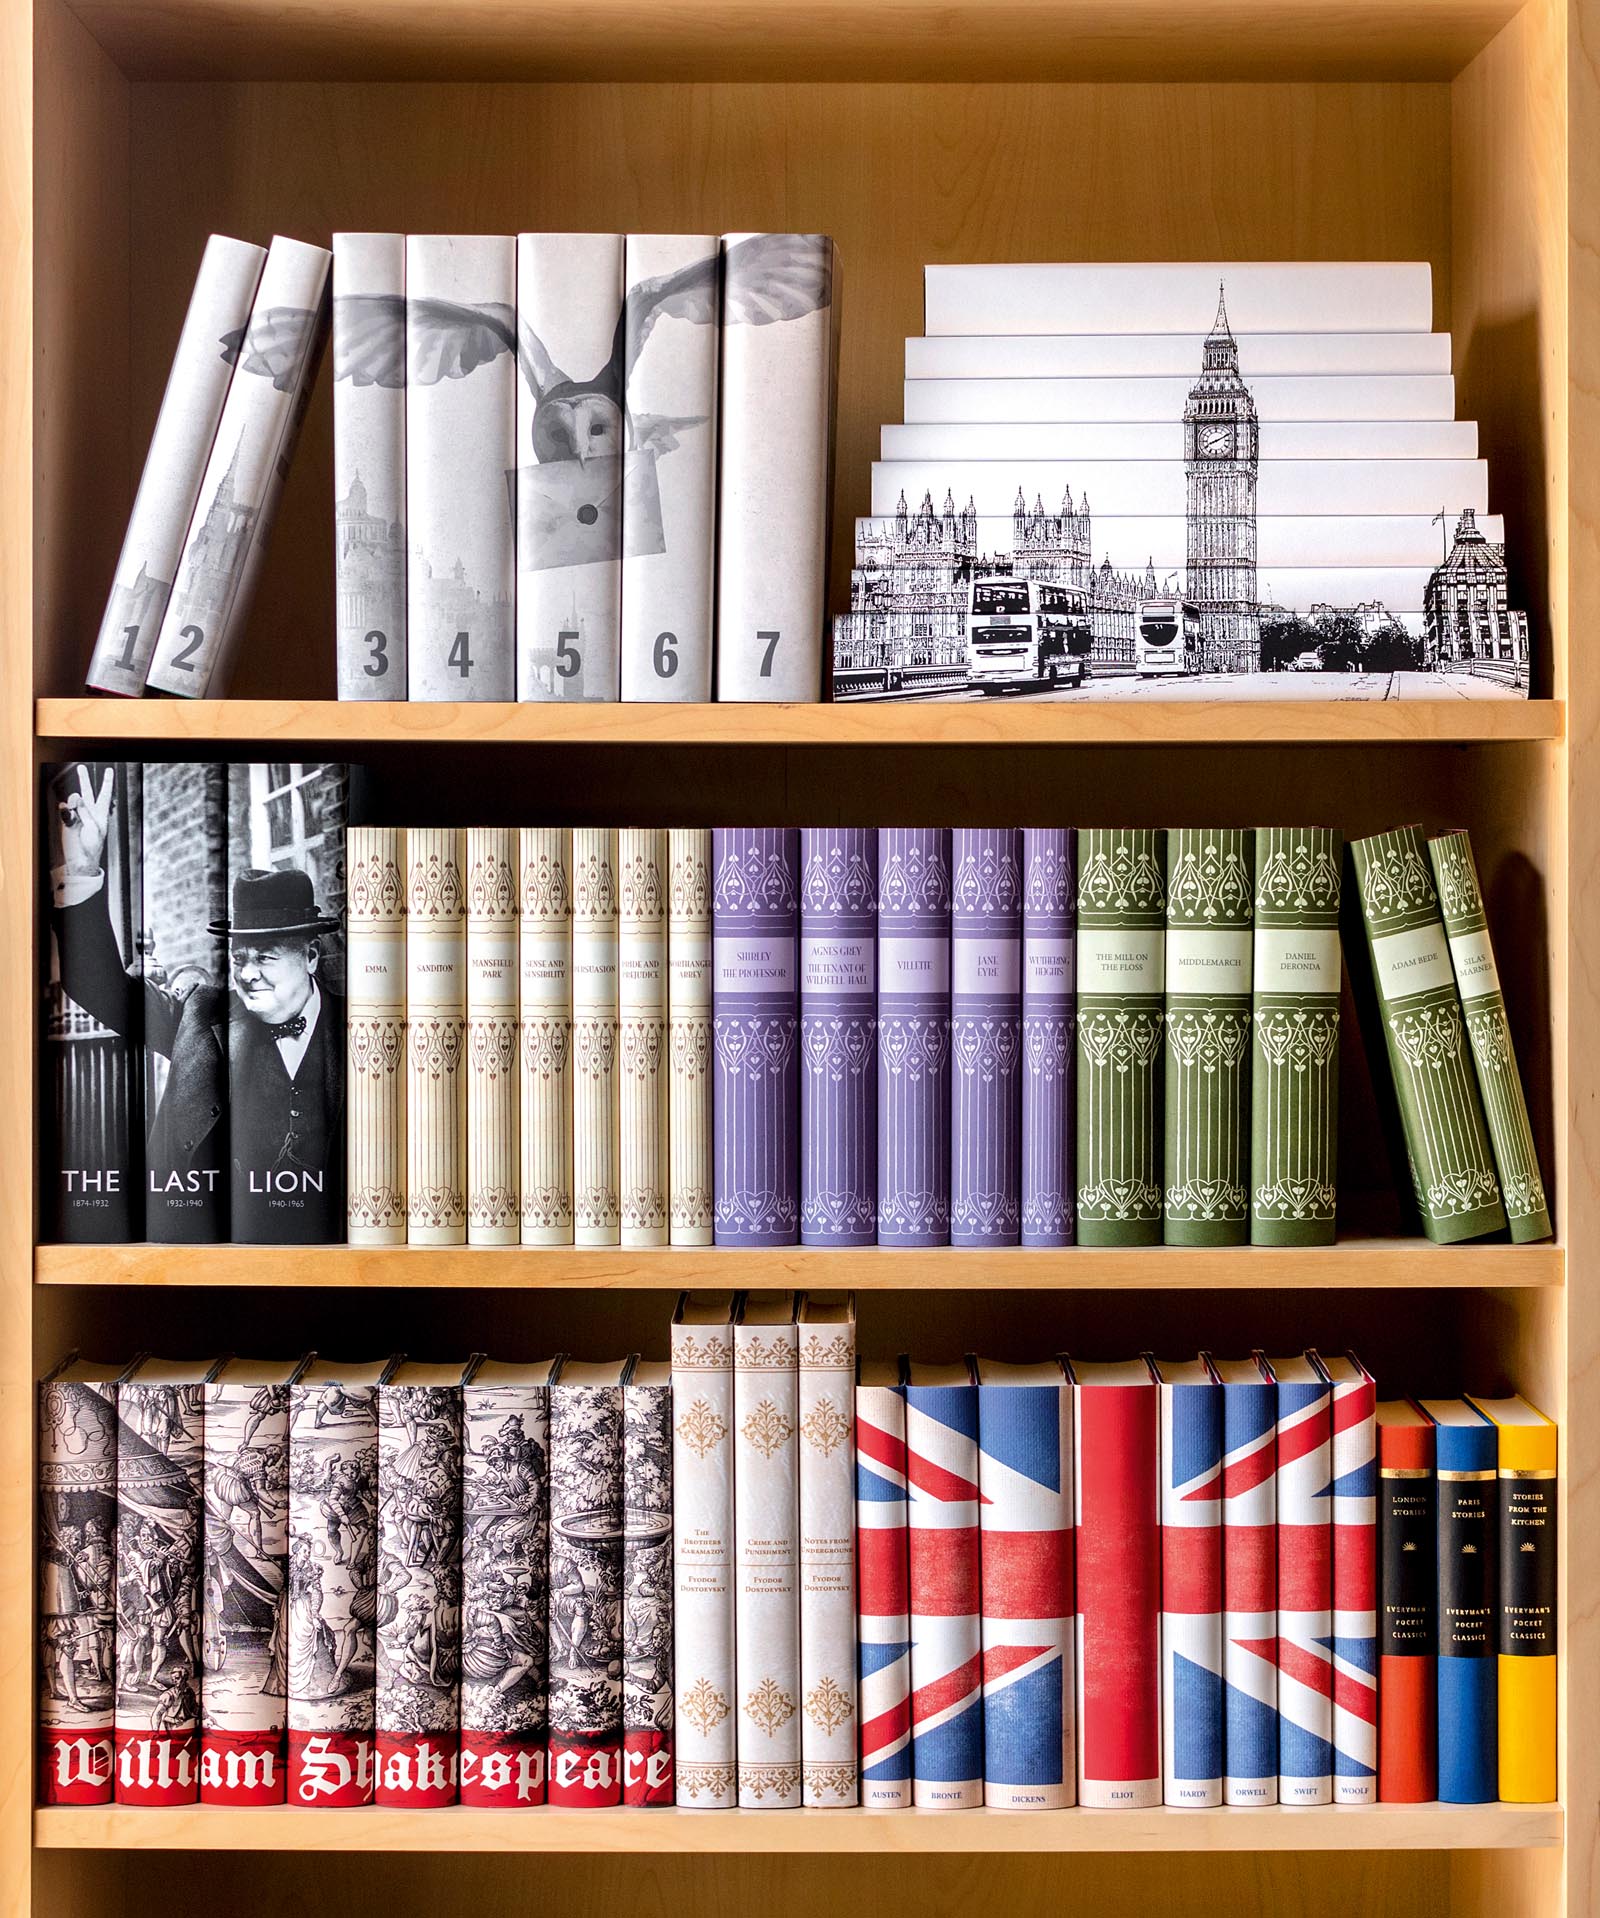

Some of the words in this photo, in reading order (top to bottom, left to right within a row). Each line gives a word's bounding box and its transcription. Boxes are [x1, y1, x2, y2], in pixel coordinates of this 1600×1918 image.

[115, 625, 140, 671] 1
[170, 625, 204, 672] 2
[364, 631, 388, 676] 3
[448, 632, 474, 677] 4
[557, 632, 581, 677] 5
[653, 632, 678, 678] 6
[756, 631, 780, 676] 7
[812, 947, 838, 955] AGNES
[840, 947, 862, 955] GREY
[737, 952, 771, 961] SHIRLEY
[978, 956, 998, 965] JANE
[1464, 954, 1486, 965] SILAS
[897, 961, 932, 970] VILLETTE
[1179, 958, 1241, 966] MIDDLEMARCH
[1392, 960, 1417, 971] ADAM
[1418, 953, 1438, 965] BEDE
[366, 965, 387, 973] EMMA
[808, 964, 822, 972] THE
[824, 964, 853, 972] TENANT
[855, 964, 866, 972] OF
[1035, 967, 1064, 975] HEIGHTS
[1280, 963, 1321, 971] DERONDA
[622, 971, 659, 979] PREJUDICE
[723, 969, 737, 977] THE
[739, 969, 786, 978] PROFESSOR
[978, 968, 998, 976] EYRE
[806, 976, 845, 984] WILDFELL
[848, 976, 868, 984] HALL
[62, 1170, 120, 1192] THE
[150, 1170, 220, 1192] LAST
[249, 1170, 323, 1193] LION
[268, 1200, 304, 1208] 1940-1965
[1505, 1606, 1550, 1614] EVERYMAN'S
[55, 1736, 276, 1788] William
[300, 1736, 671, 1801] Shakespeare
[872, 1791, 901, 1799] AUSTEN
[1236, 1788, 1268, 1796] ORWELL
[1341, 1787, 1370, 1795] WOOLF
